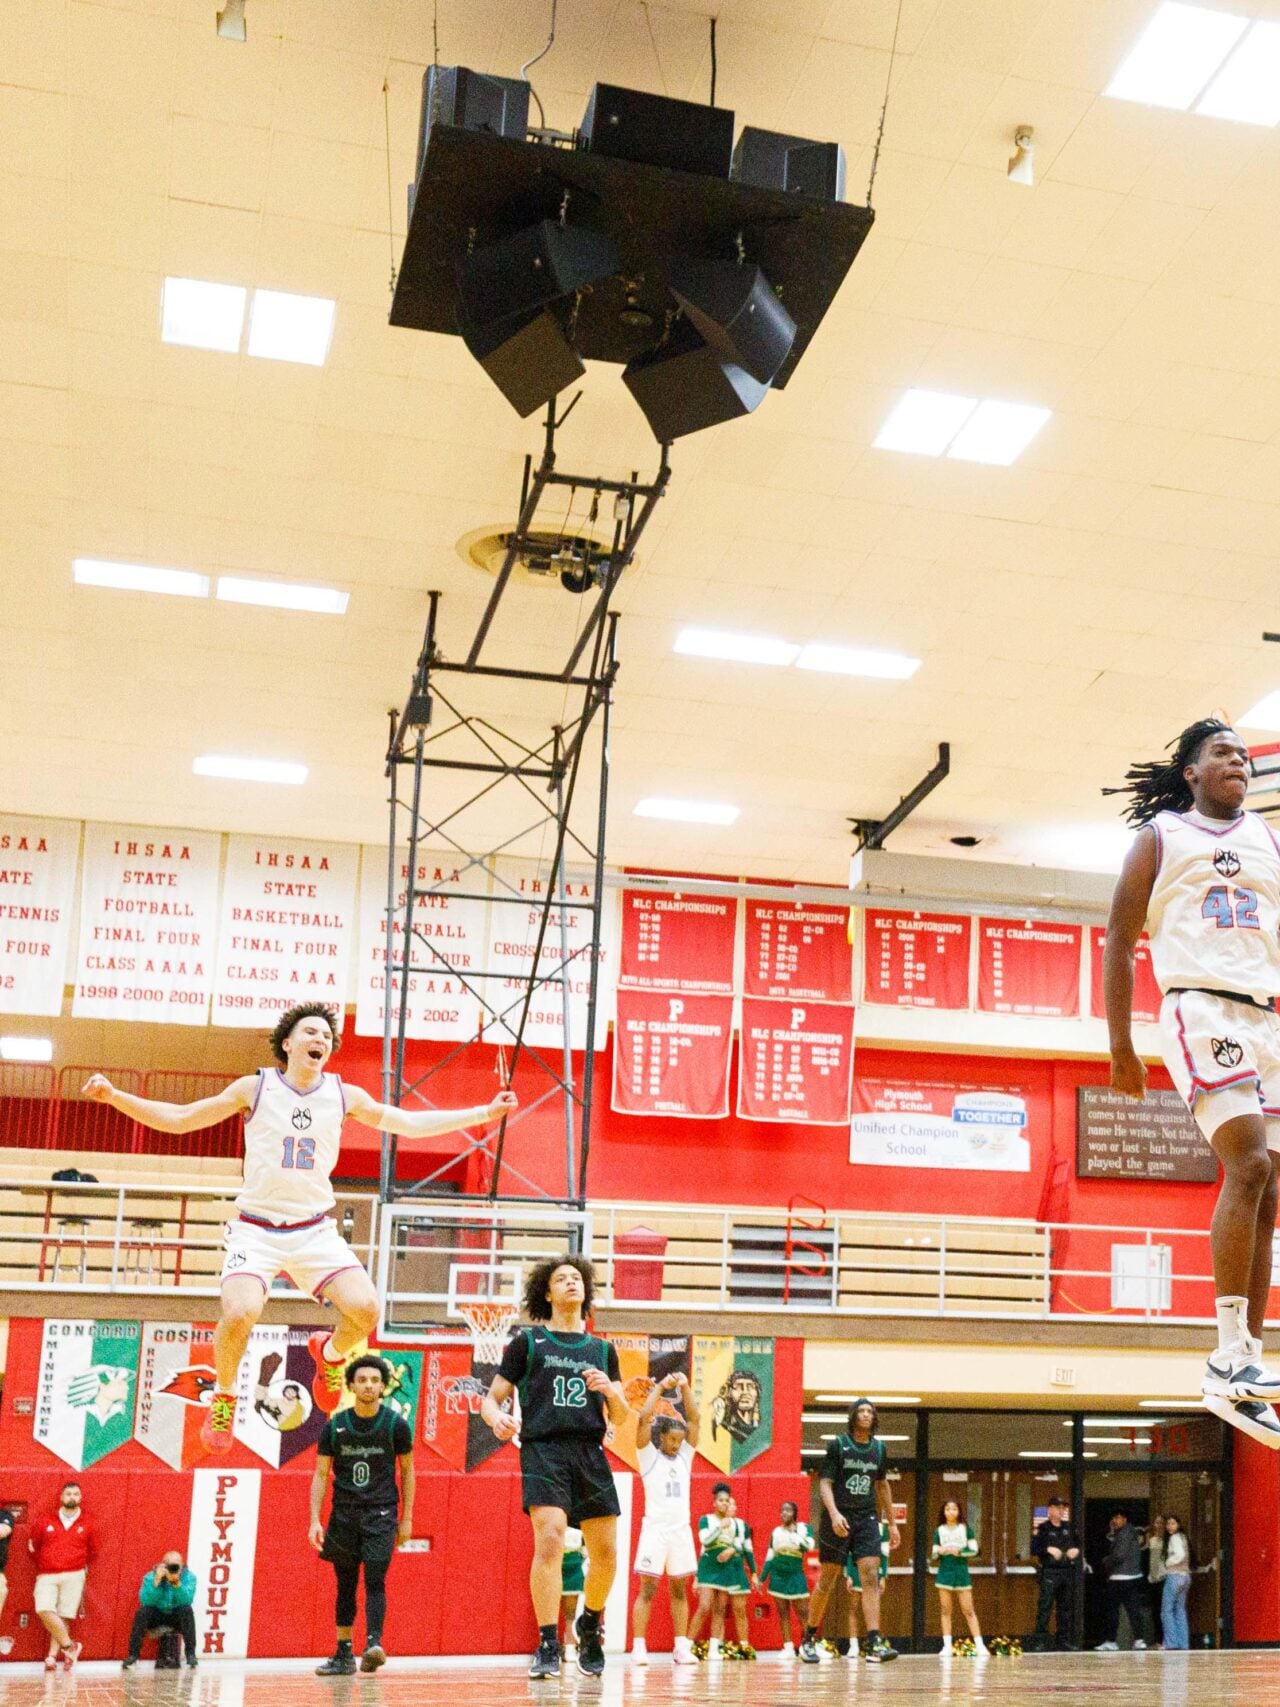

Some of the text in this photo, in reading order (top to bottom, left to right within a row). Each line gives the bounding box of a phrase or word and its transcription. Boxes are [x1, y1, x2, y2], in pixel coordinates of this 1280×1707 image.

[123, 870, 178, 887] STATE
[264, 881, 317, 898] STATE
[104, 898, 195, 916] FOOTBALL
[633, 898, 726, 915] NLC CHAMPIONSHIPS
[1201, 885, 1260, 930] 42
[232, 907, 343, 928] BASKETBALL
[756, 908, 844, 924] NLC CHAMPIONSHIPS
[875, 918, 962, 934] NLC CHAMPIONSHIPS
[93, 927, 201, 946] FINAL FOUR
[986, 928, 1075, 944] NLC CHAMPIONSHIPS
[6, 941, 52, 957] FOUR
[232, 936, 338, 956] FINAL FOUR
[86, 956, 136, 970] CLASS
[227, 965, 279, 981] CLASS
[80, 985, 205, 1005] 1998 2000 2001
[218, 993, 253, 1008] 1998
[423, 1009, 460, 1022] 2002
[669, 999, 684, 1022] P
[791, 1008, 806, 1030] P
[627, 1020, 721, 1036] NLC CHAMPIONSHIPS
[751, 1028, 843, 1045] NLC CHAMPIONSHIPS
[883, 1088, 924, 1101] Plymouth
[1084, 1091, 1097, 1103] For
[1100, 1092, 1122, 1104] when
[874, 1099, 933, 1113] High School
[958, 1110, 1022, 1124] TOGETHER
[1088, 1110, 1188, 1124] comes to write against
[854, 1121, 959, 1140] Unified Champion
[1088, 1126, 1112, 1136] name
[1114, 1124, 1127, 1137] He
[1180, 1130, 1197, 1141] that
[281, 1136, 316, 1170] 12
[887, 1142, 927, 1156] School
[1088, 1142, 1107, 1152] won
[1110, 1143, 1119, 1152] or
[1122, 1141, 1139, 1154] lost
[1149, 1142, 1167, 1154] but
[1170, 1144, 1189, 1155] how
[1088, 1156, 1122, 1171] played
[1126, 1157, 1142, 1169] the
[49, 1324, 136, 1337] CONCORD
[154, 1330, 215, 1344] GOSHE
[611, 1338, 687, 1351] WARSAW
[1056, 1368, 1074, 1382] EXIT
[38, 1340, 58, 1437] MINUTEMEN
[141, 1347, 155, 1435] REDHAWKS
[553, 1375, 588, 1407] 12
[353, 1461, 370, 1487] 0
[845, 1474, 871, 1495] 42
[202, 1475, 238, 1653] PLYMOUTH
